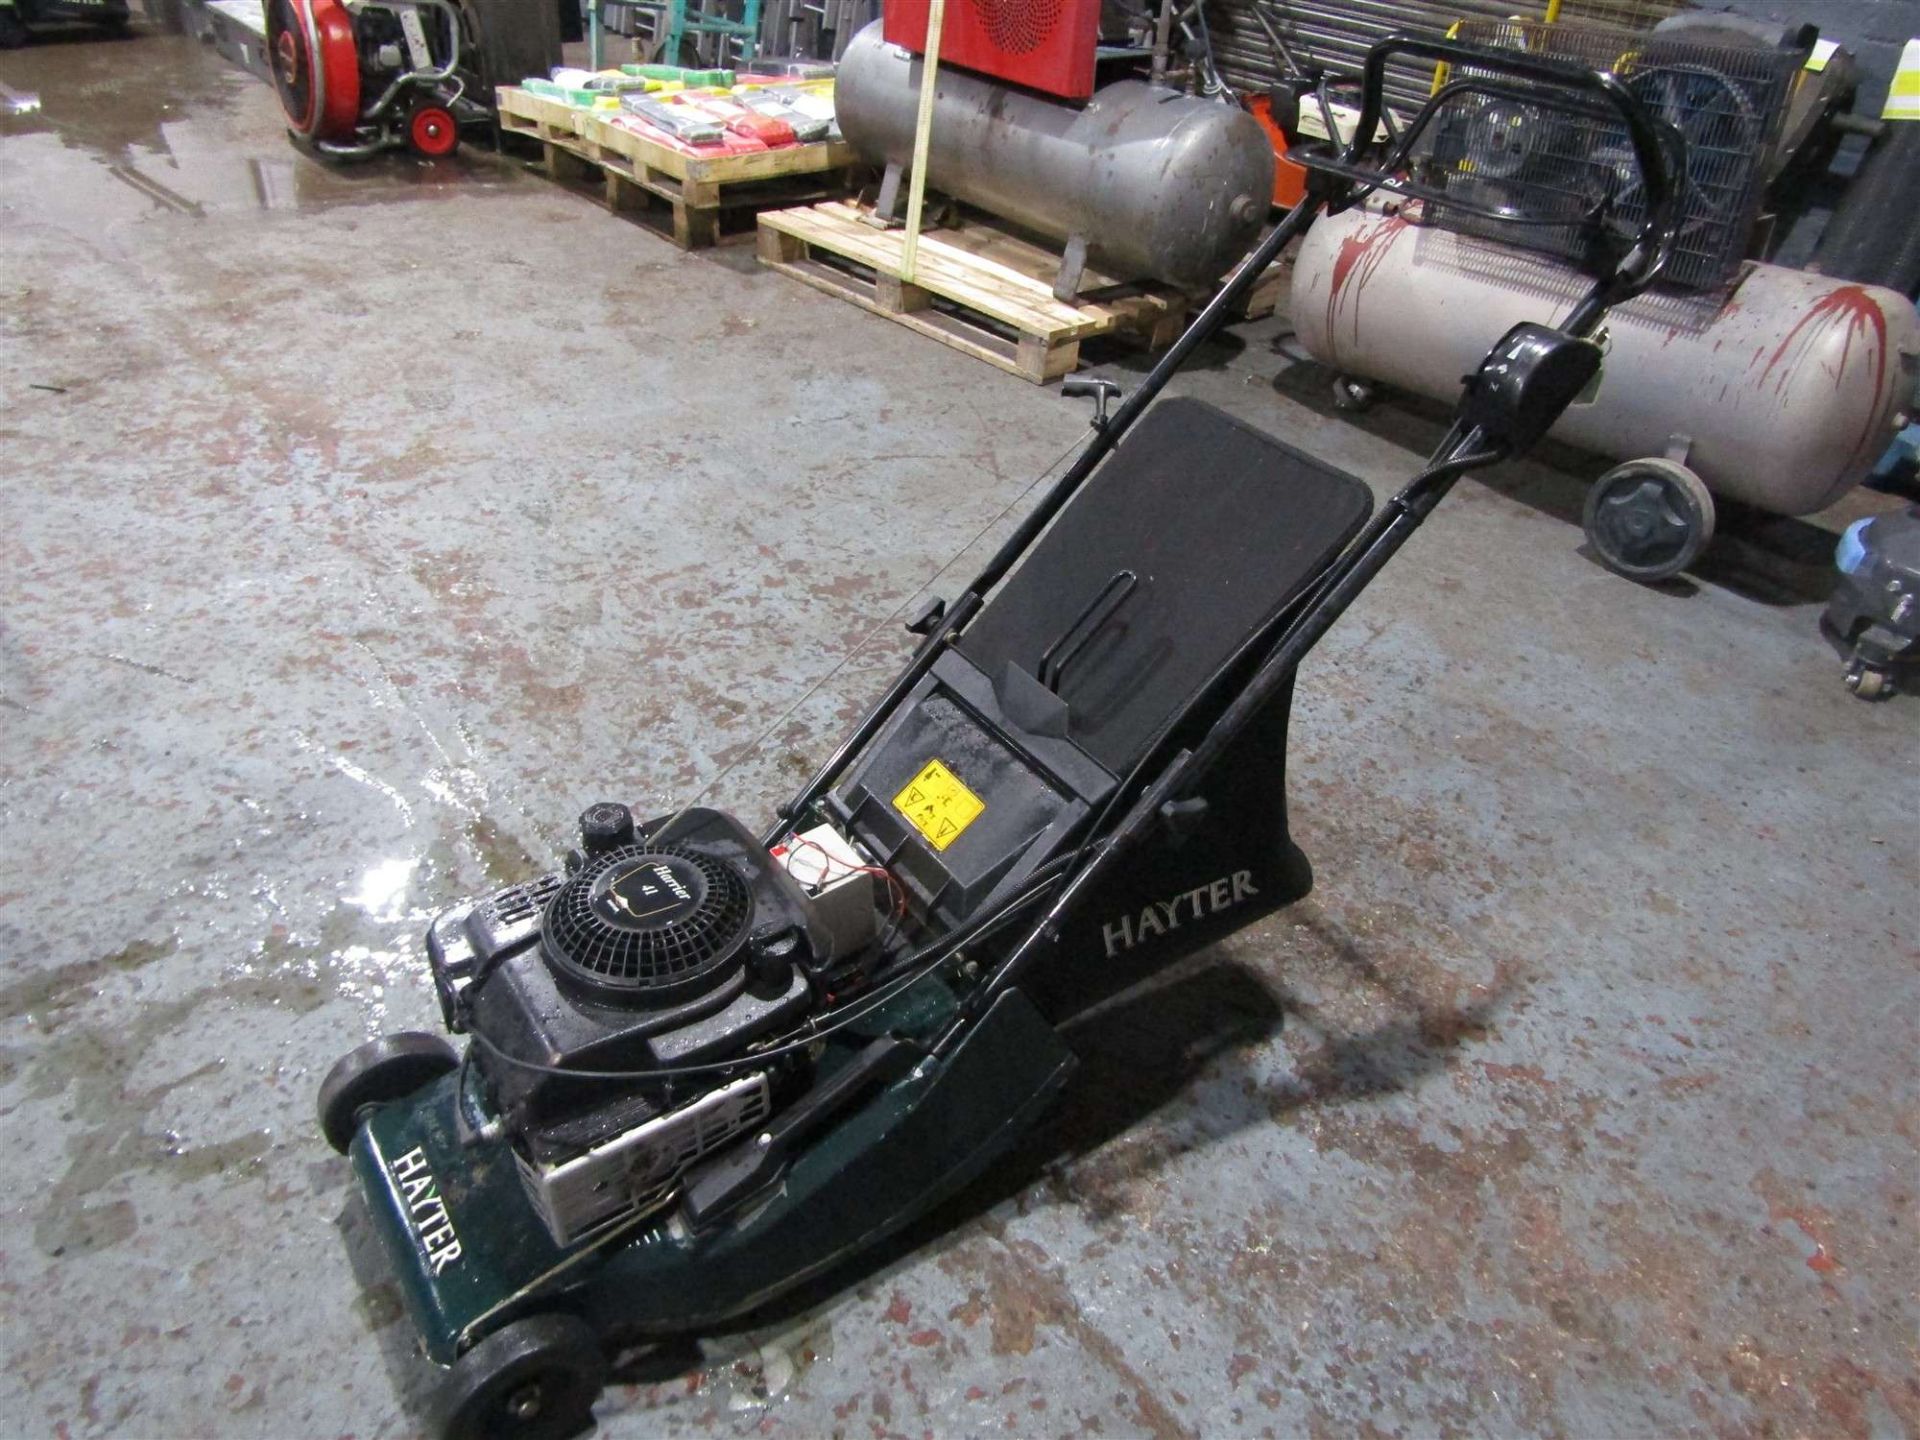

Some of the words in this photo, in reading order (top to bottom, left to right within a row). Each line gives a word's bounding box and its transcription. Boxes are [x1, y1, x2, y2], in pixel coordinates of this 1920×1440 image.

[653, 865, 691, 899] Harrier
[1102, 870, 1259, 959] HAYTER
[393, 1145, 462, 1277] HAYTER
